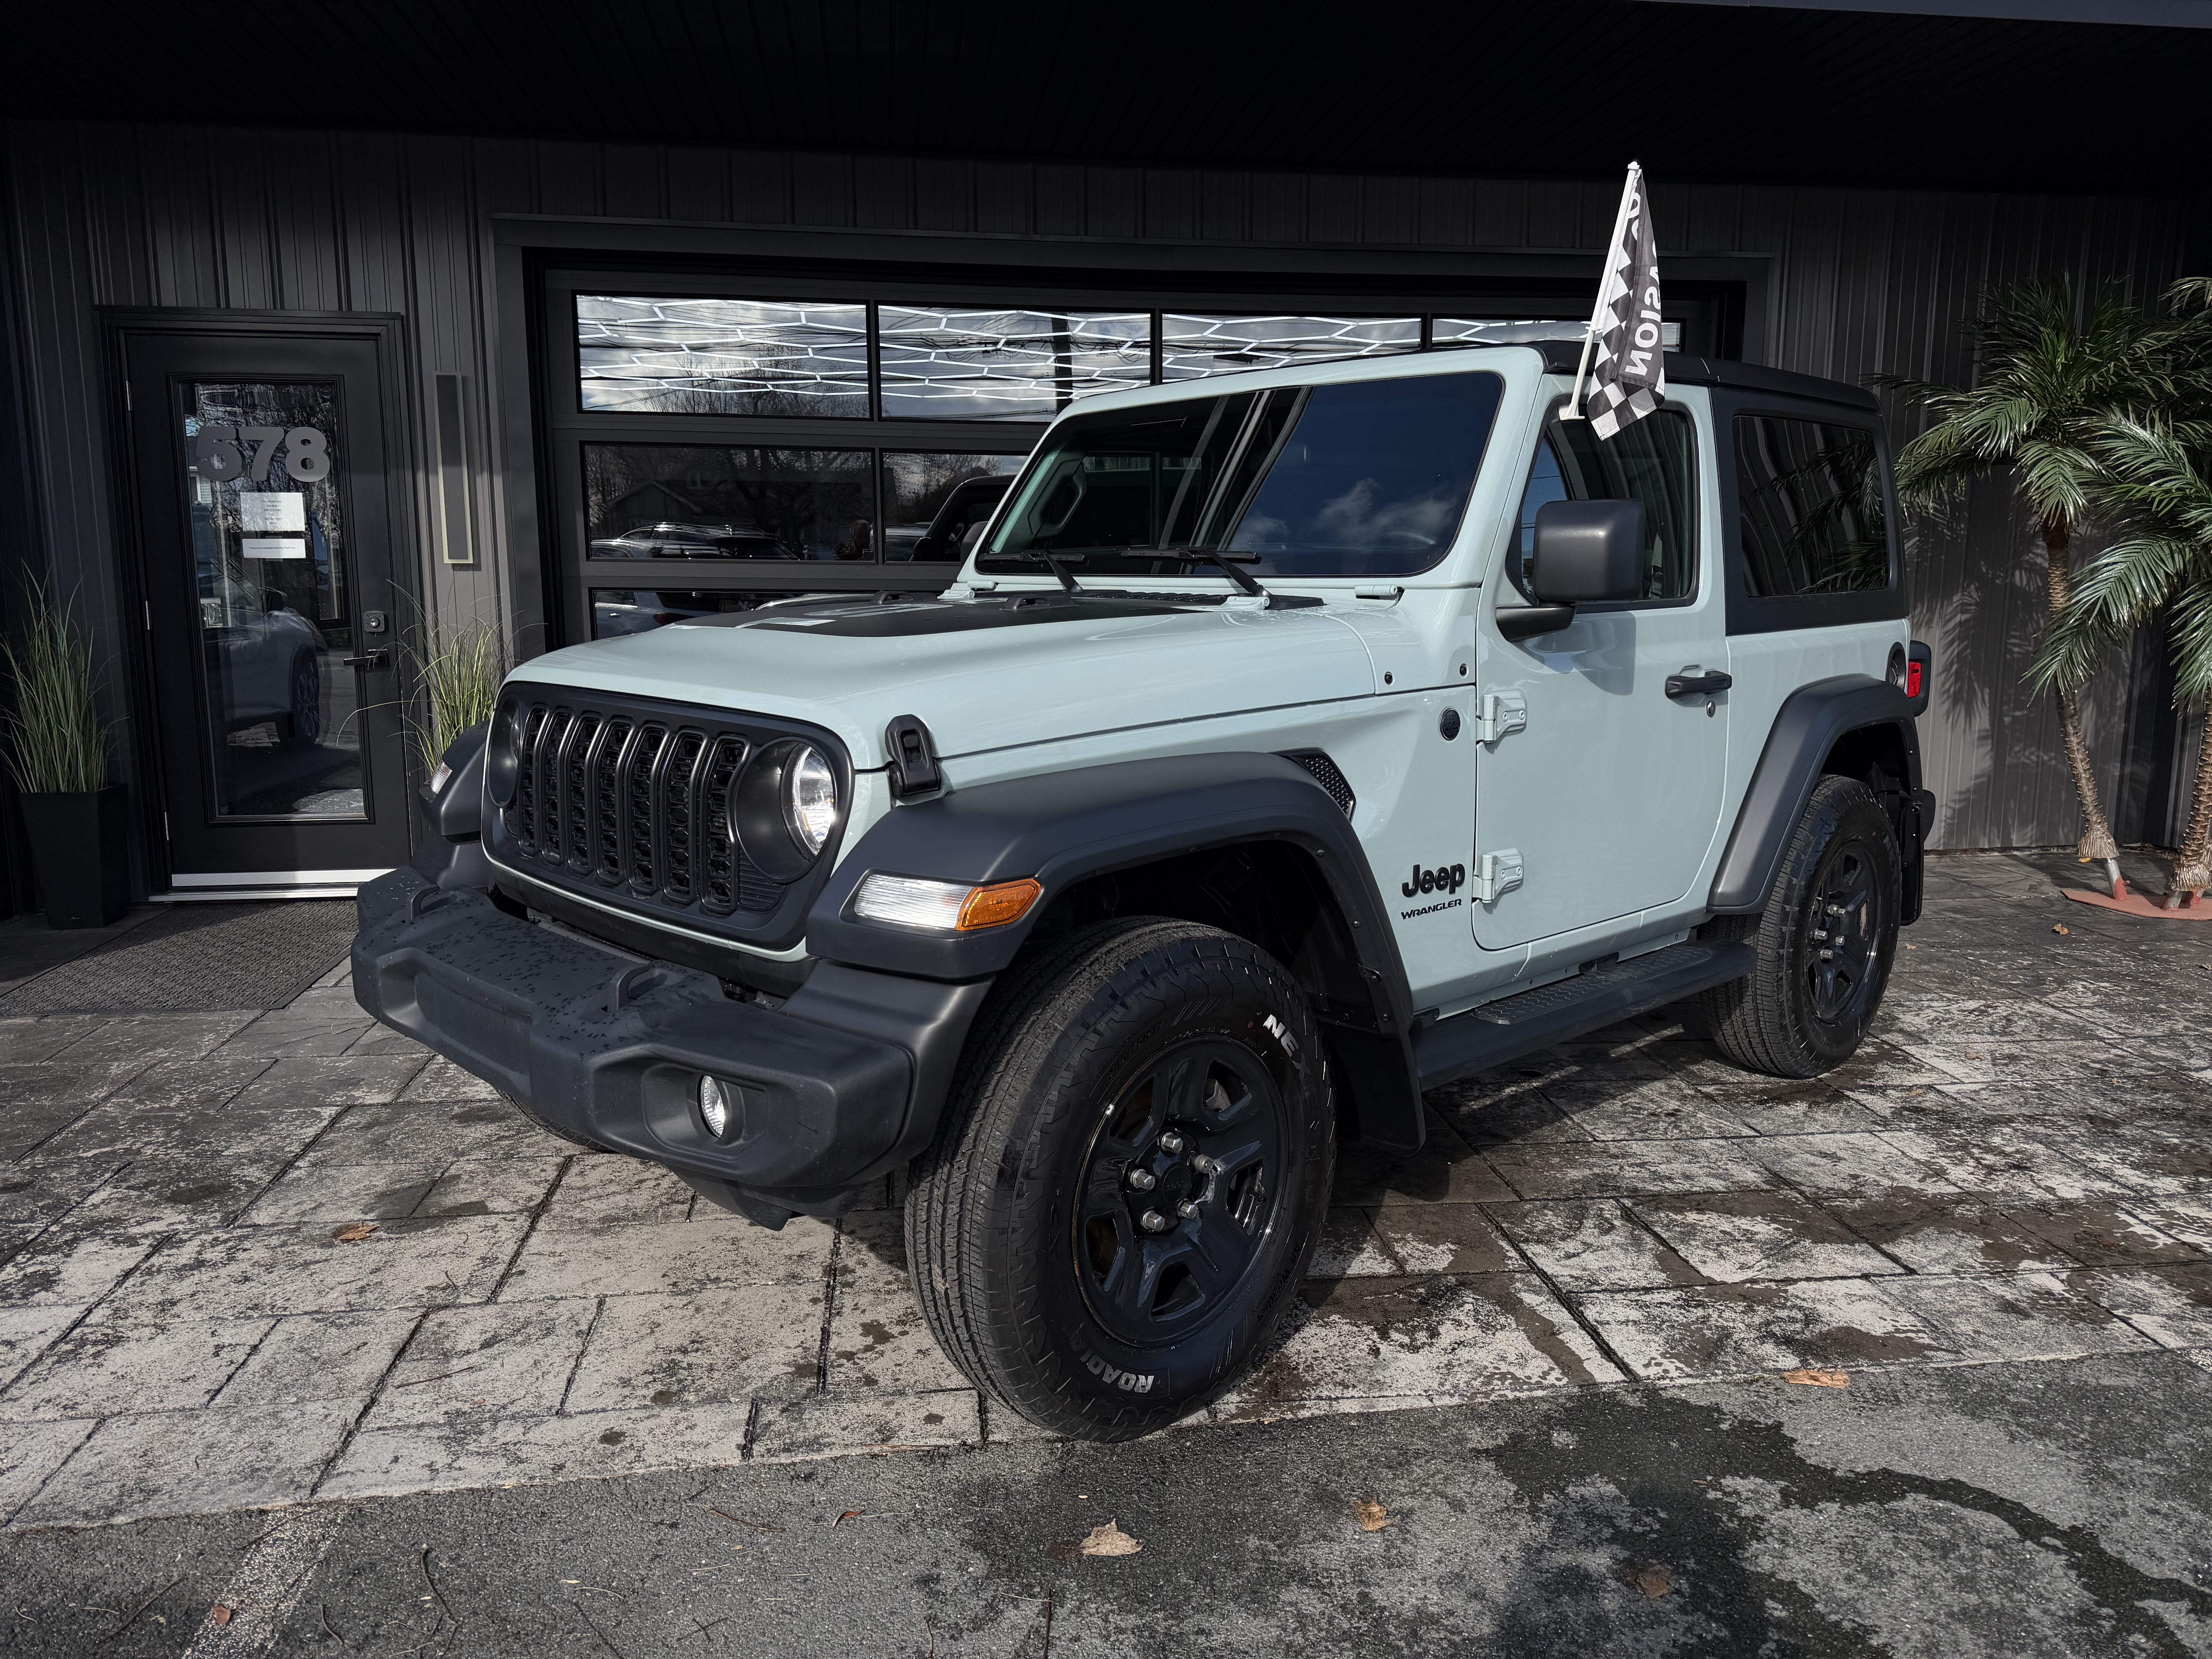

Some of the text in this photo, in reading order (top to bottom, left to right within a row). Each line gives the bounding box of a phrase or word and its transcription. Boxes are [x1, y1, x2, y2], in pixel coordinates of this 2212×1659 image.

[195, 426, 330, 482] 578
[1402, 864, 1465, 898] Jeep
[1401, 898, 1462, 920] WRANGLER
